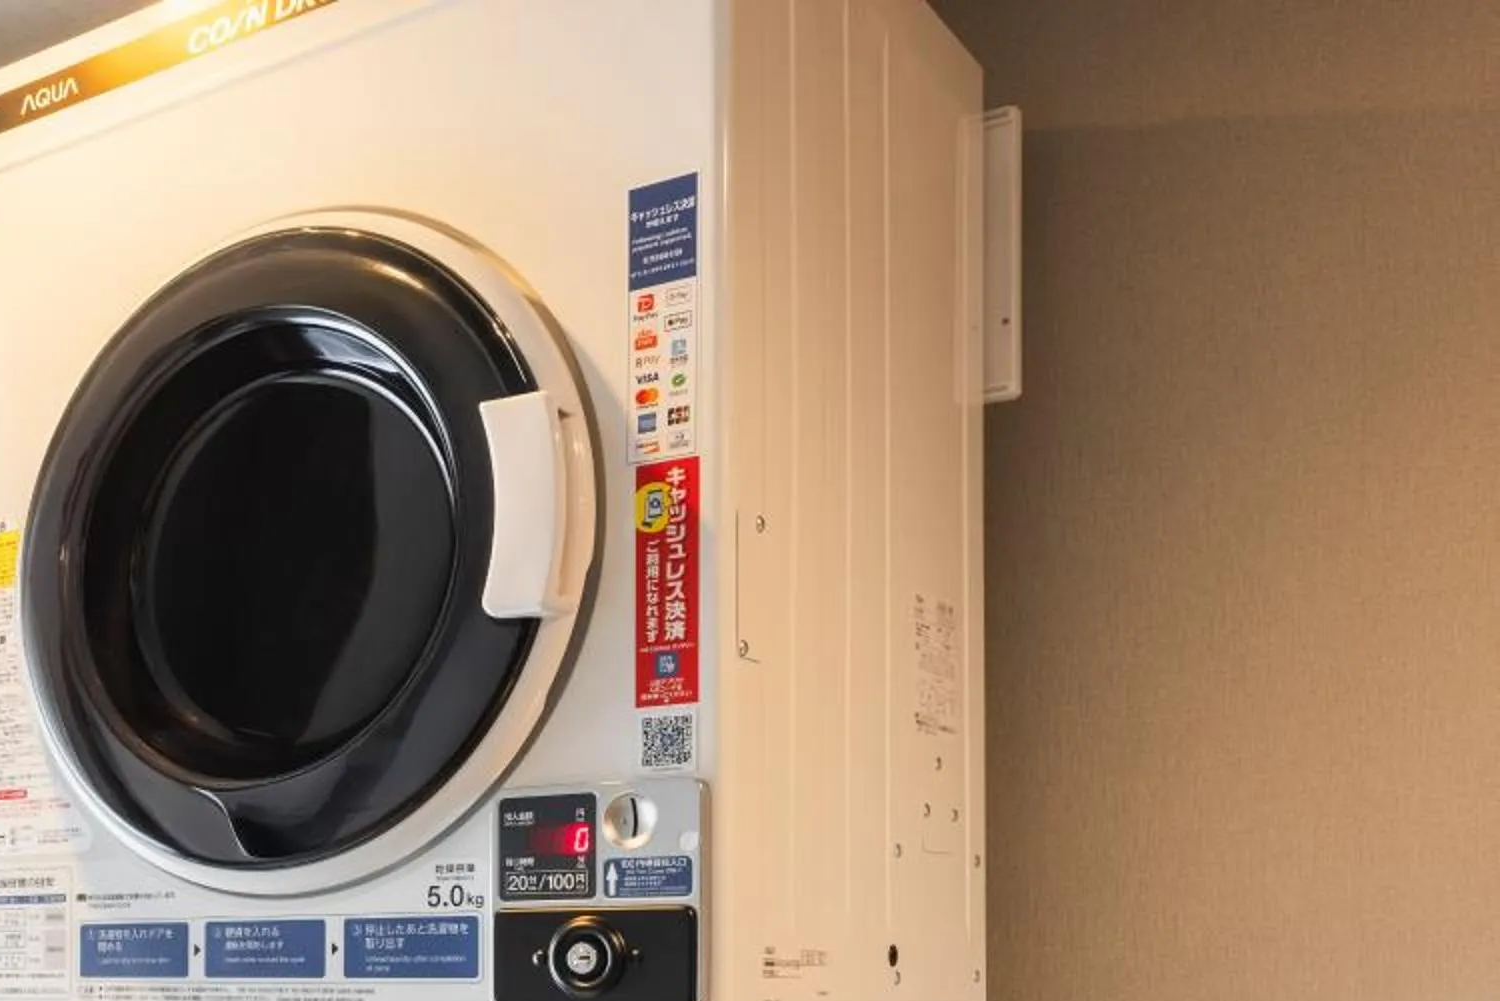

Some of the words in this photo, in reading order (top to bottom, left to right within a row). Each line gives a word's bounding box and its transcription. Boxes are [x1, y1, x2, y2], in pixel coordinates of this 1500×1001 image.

[19, 77, 80, 116] AQUA
[635, 372, 659, 385] VISA
[664, 466, 687, 641] キャッシュレス決済
[573, 827, 589, 852] 0
